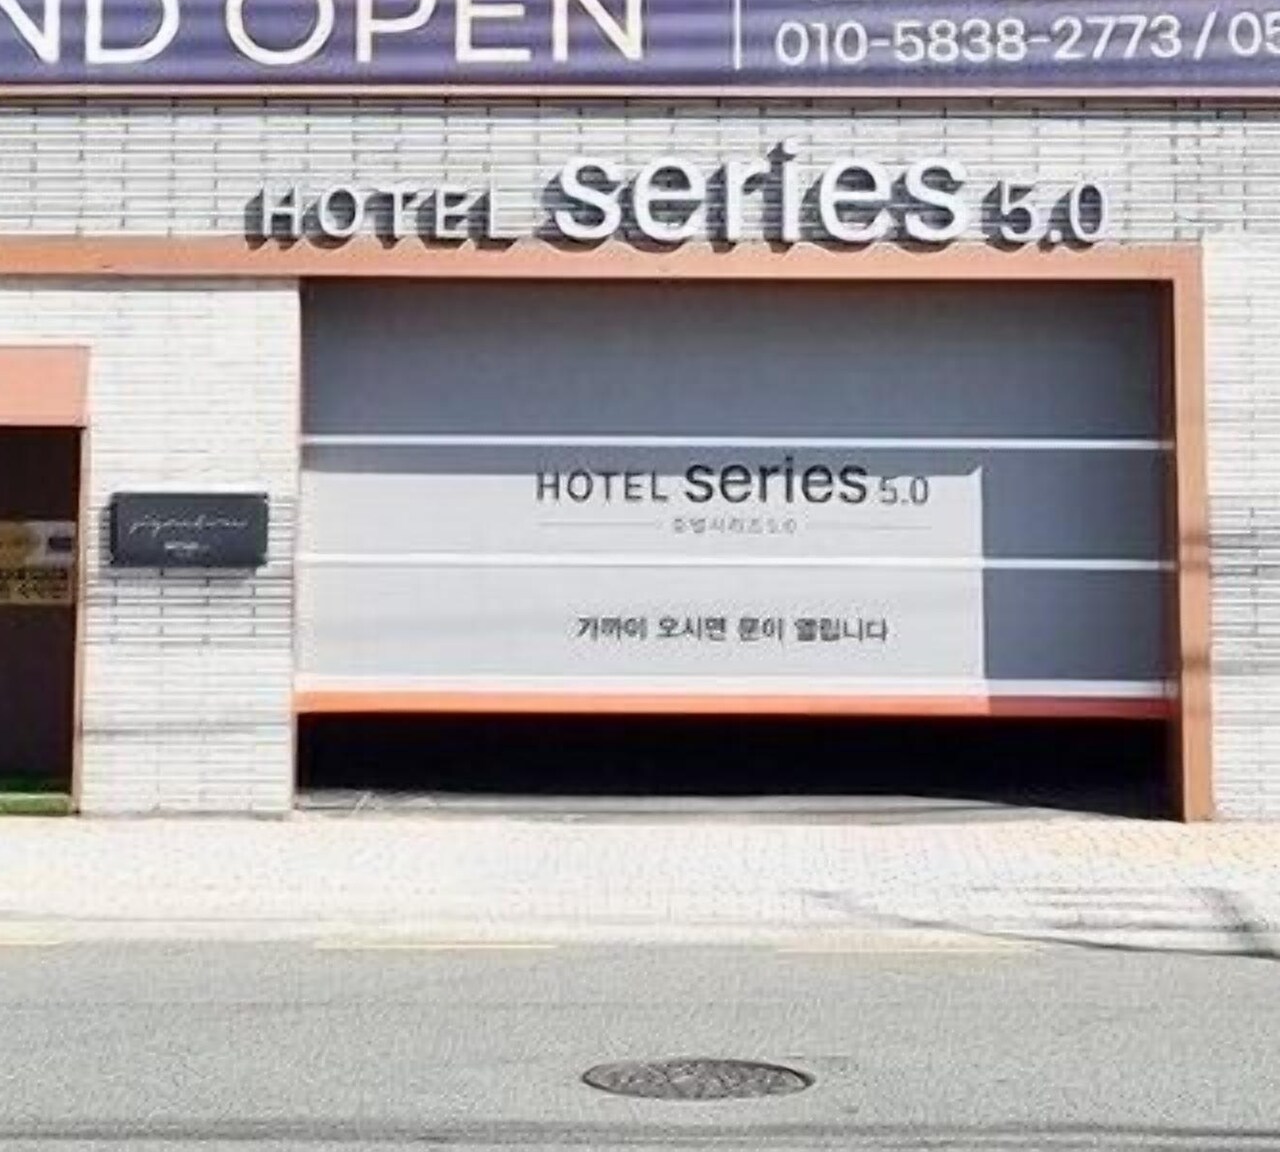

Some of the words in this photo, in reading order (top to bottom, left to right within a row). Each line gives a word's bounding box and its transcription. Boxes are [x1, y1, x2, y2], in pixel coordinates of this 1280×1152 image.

[775, 13, 1183, 68] 010-5838-2773
[258, 182, 520, 240] HOTEL
[556, 136, 965, 243] series
[996, 180, 1110, 240] 5.0
[536, 470, 668, 502] HOTEL
[685, 456, 868, 504] series
[879, 475, 930, 505] 5.0
[576, 616, 648, 641] 가까이
[657, 616, 726, 641] 오시면
[738, 616, 784, 641] 문이
[794, 616, 888, 642] 열립니다
